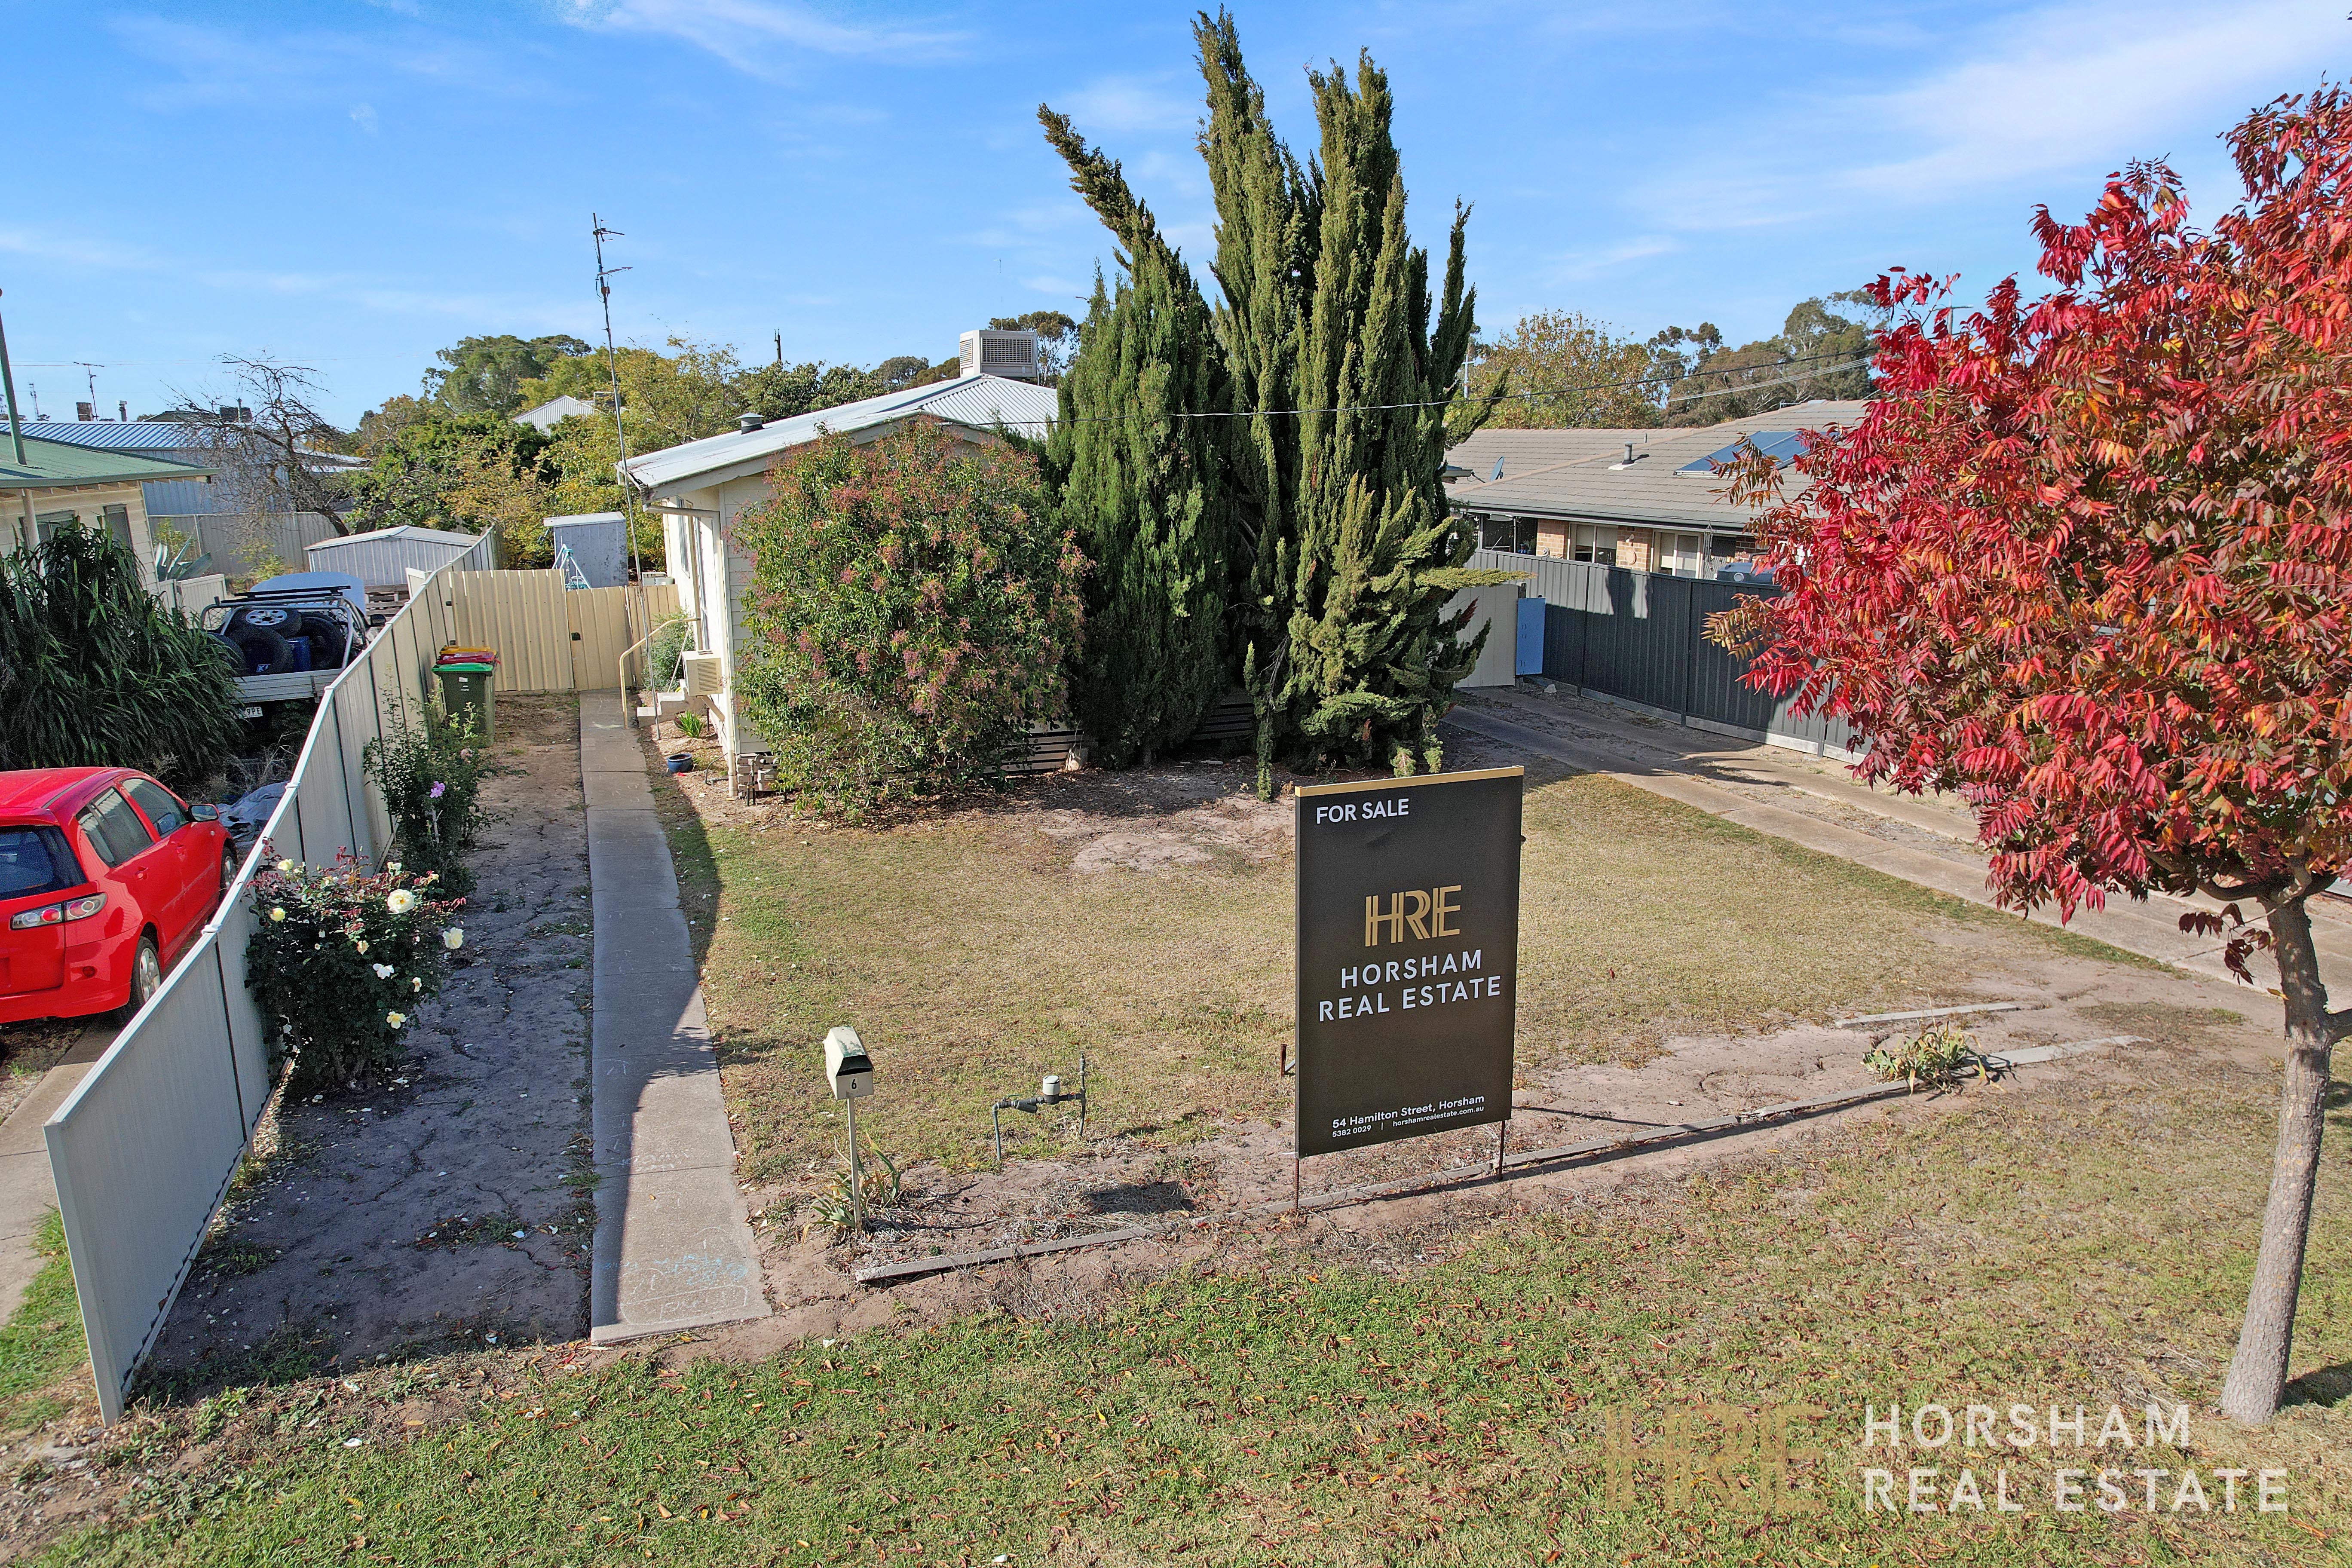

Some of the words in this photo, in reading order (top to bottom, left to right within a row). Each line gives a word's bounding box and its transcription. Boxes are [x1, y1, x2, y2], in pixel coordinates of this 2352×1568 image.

[1317, 804, 1357, 824] FOR
[1362, 798, 1409, 819] SALE
[1365, 885, 1461, 947] HRE
[1341, 949, 1481, 989] HORSHAM
[1319, 992, 1390, 1022] REAL
[1403, 976, 1501, 1009] ESTATE
[851, 1079, 857, 1089] 6
[1332, 1118, 1347, 1128] 54
[1350, 1110, 1398, 1126] Hamilton
[1400, 1103, 1436, 1116] Street,
[1439, 1096, 1485, 1110] Horsham
[1332, 1129, 1351, 1137] 5382
[1353, 1125, 1372, 1133] 0029
[1393, 1106, 1484, 1127] horshamrealestate.com.au
